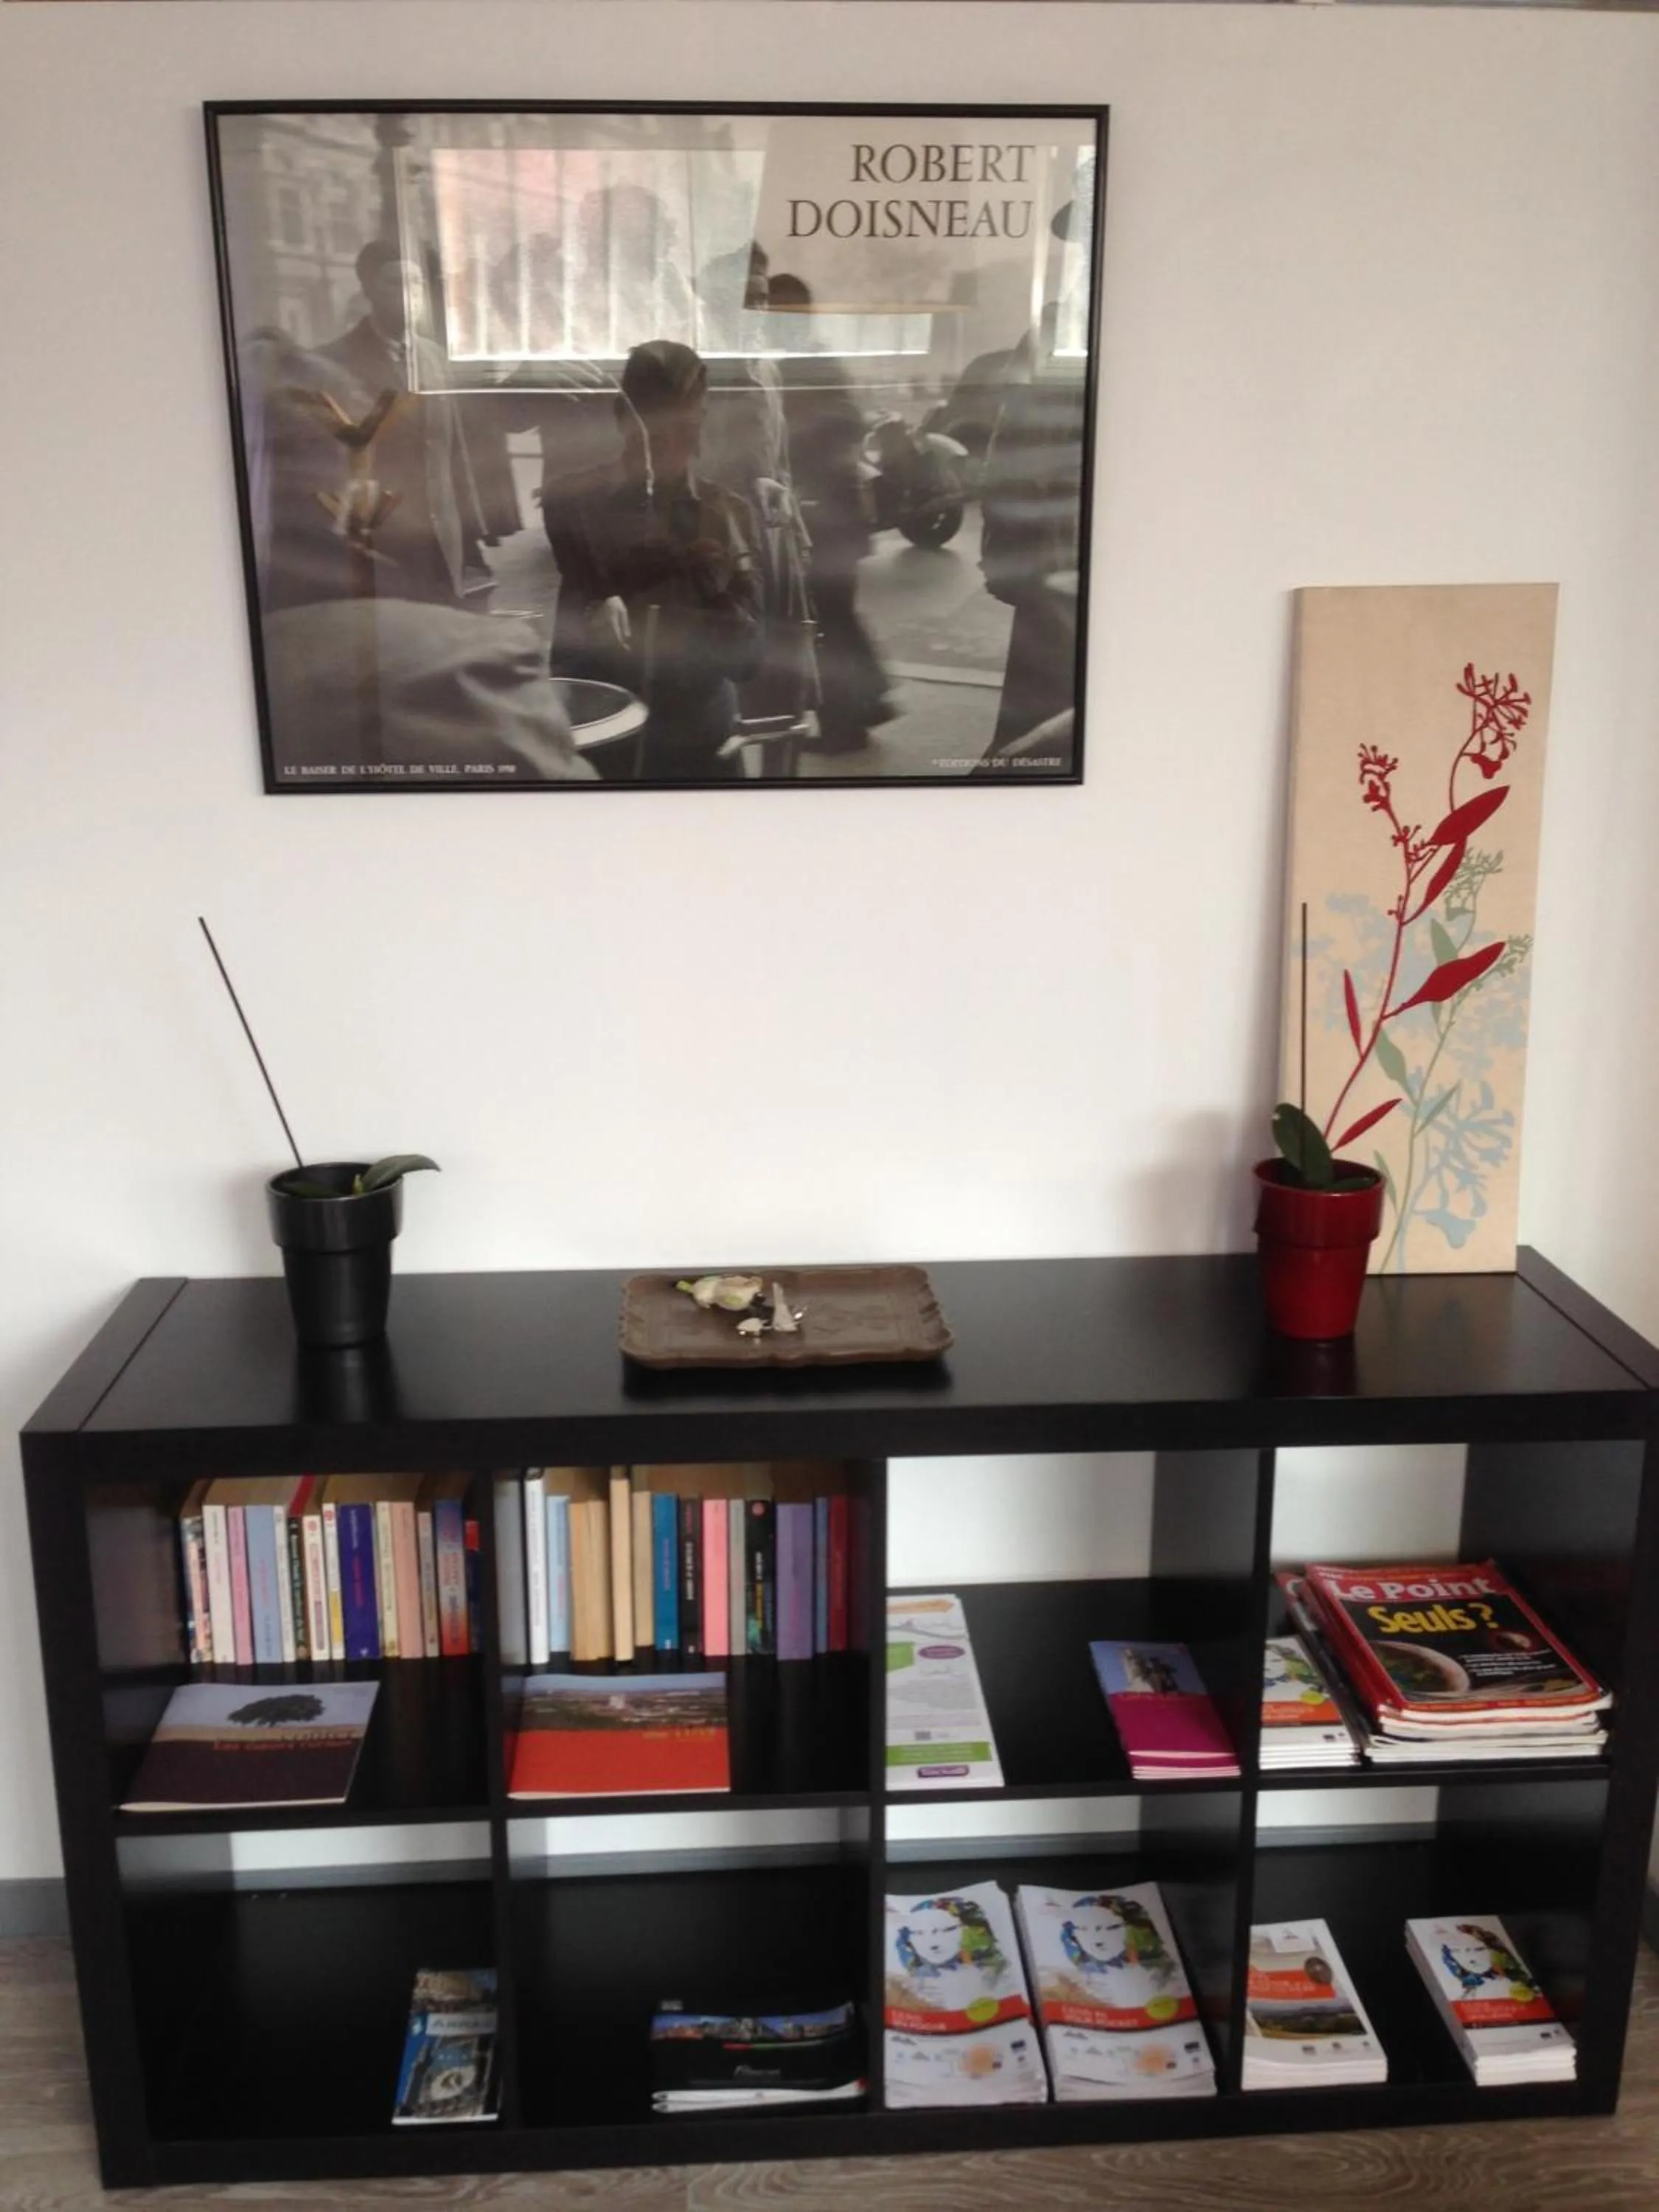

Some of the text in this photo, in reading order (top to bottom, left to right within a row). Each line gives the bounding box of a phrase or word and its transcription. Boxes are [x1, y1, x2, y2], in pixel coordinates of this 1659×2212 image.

[850, 144, 1036, 183] ROBERT
[786, 199, 1034, 238] DOISNEAU
[283, 765, 296, 775] LE
[301, 765, 337, 775] BAISER
[341, 765, 356, 775] DE
[409, 765, 425, 774] DE
[464, 764, 495, 774] PARIS
[1322, 1579, 1377, 1601] Le
[1377, 1577, 1497, 1599] Point
